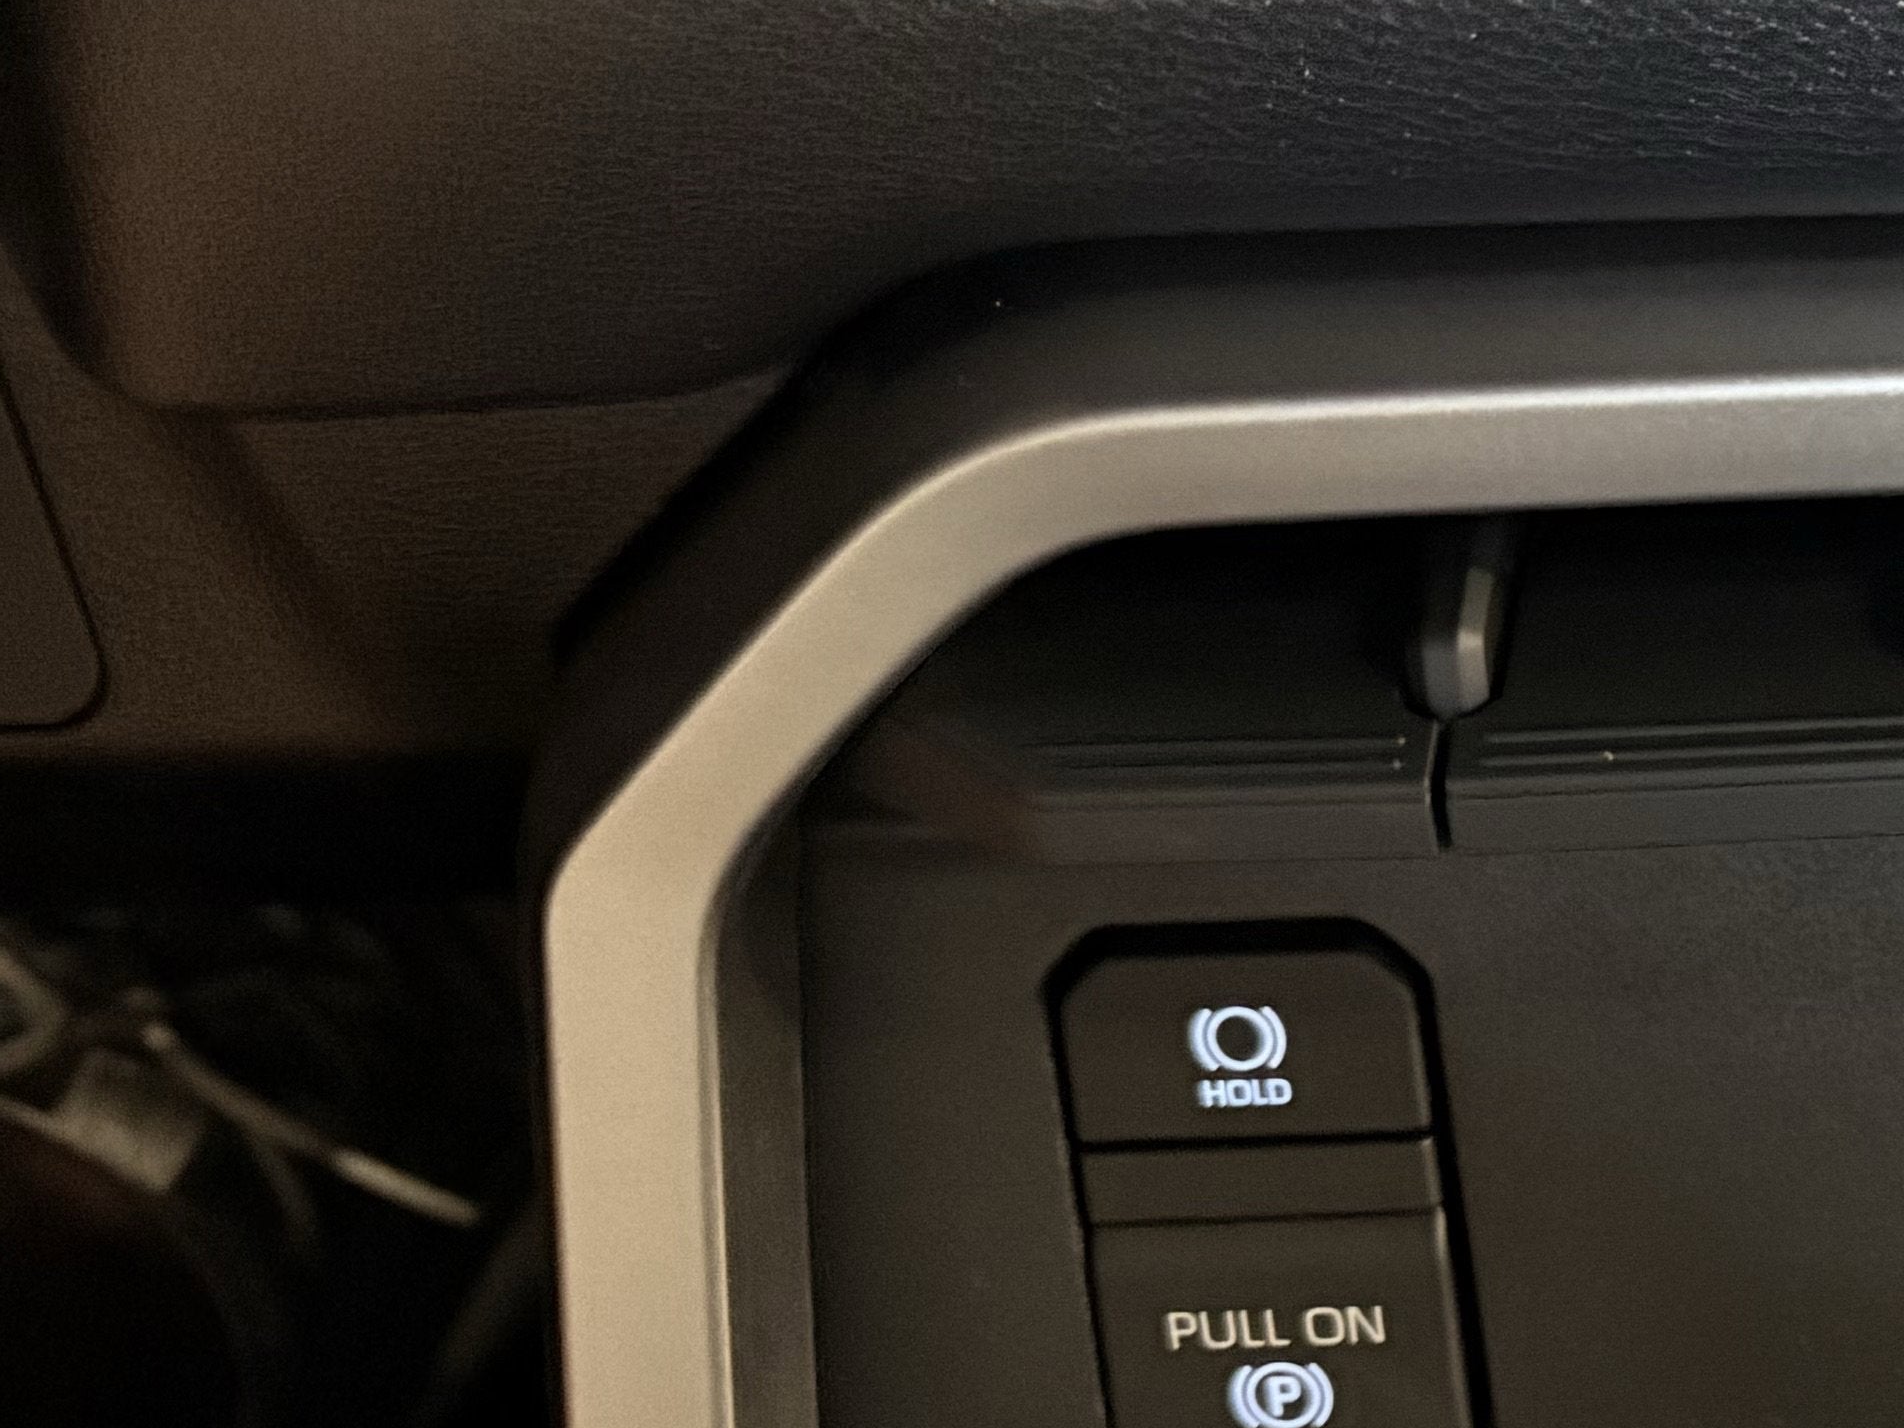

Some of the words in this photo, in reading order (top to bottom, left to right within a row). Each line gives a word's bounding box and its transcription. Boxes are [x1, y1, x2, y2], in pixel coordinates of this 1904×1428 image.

[1196, 1076, 1295, 1109] HOLD
[1164, 1307, 1292, 1352] PULL
[1302, 1303, 1387, 1348] ON
